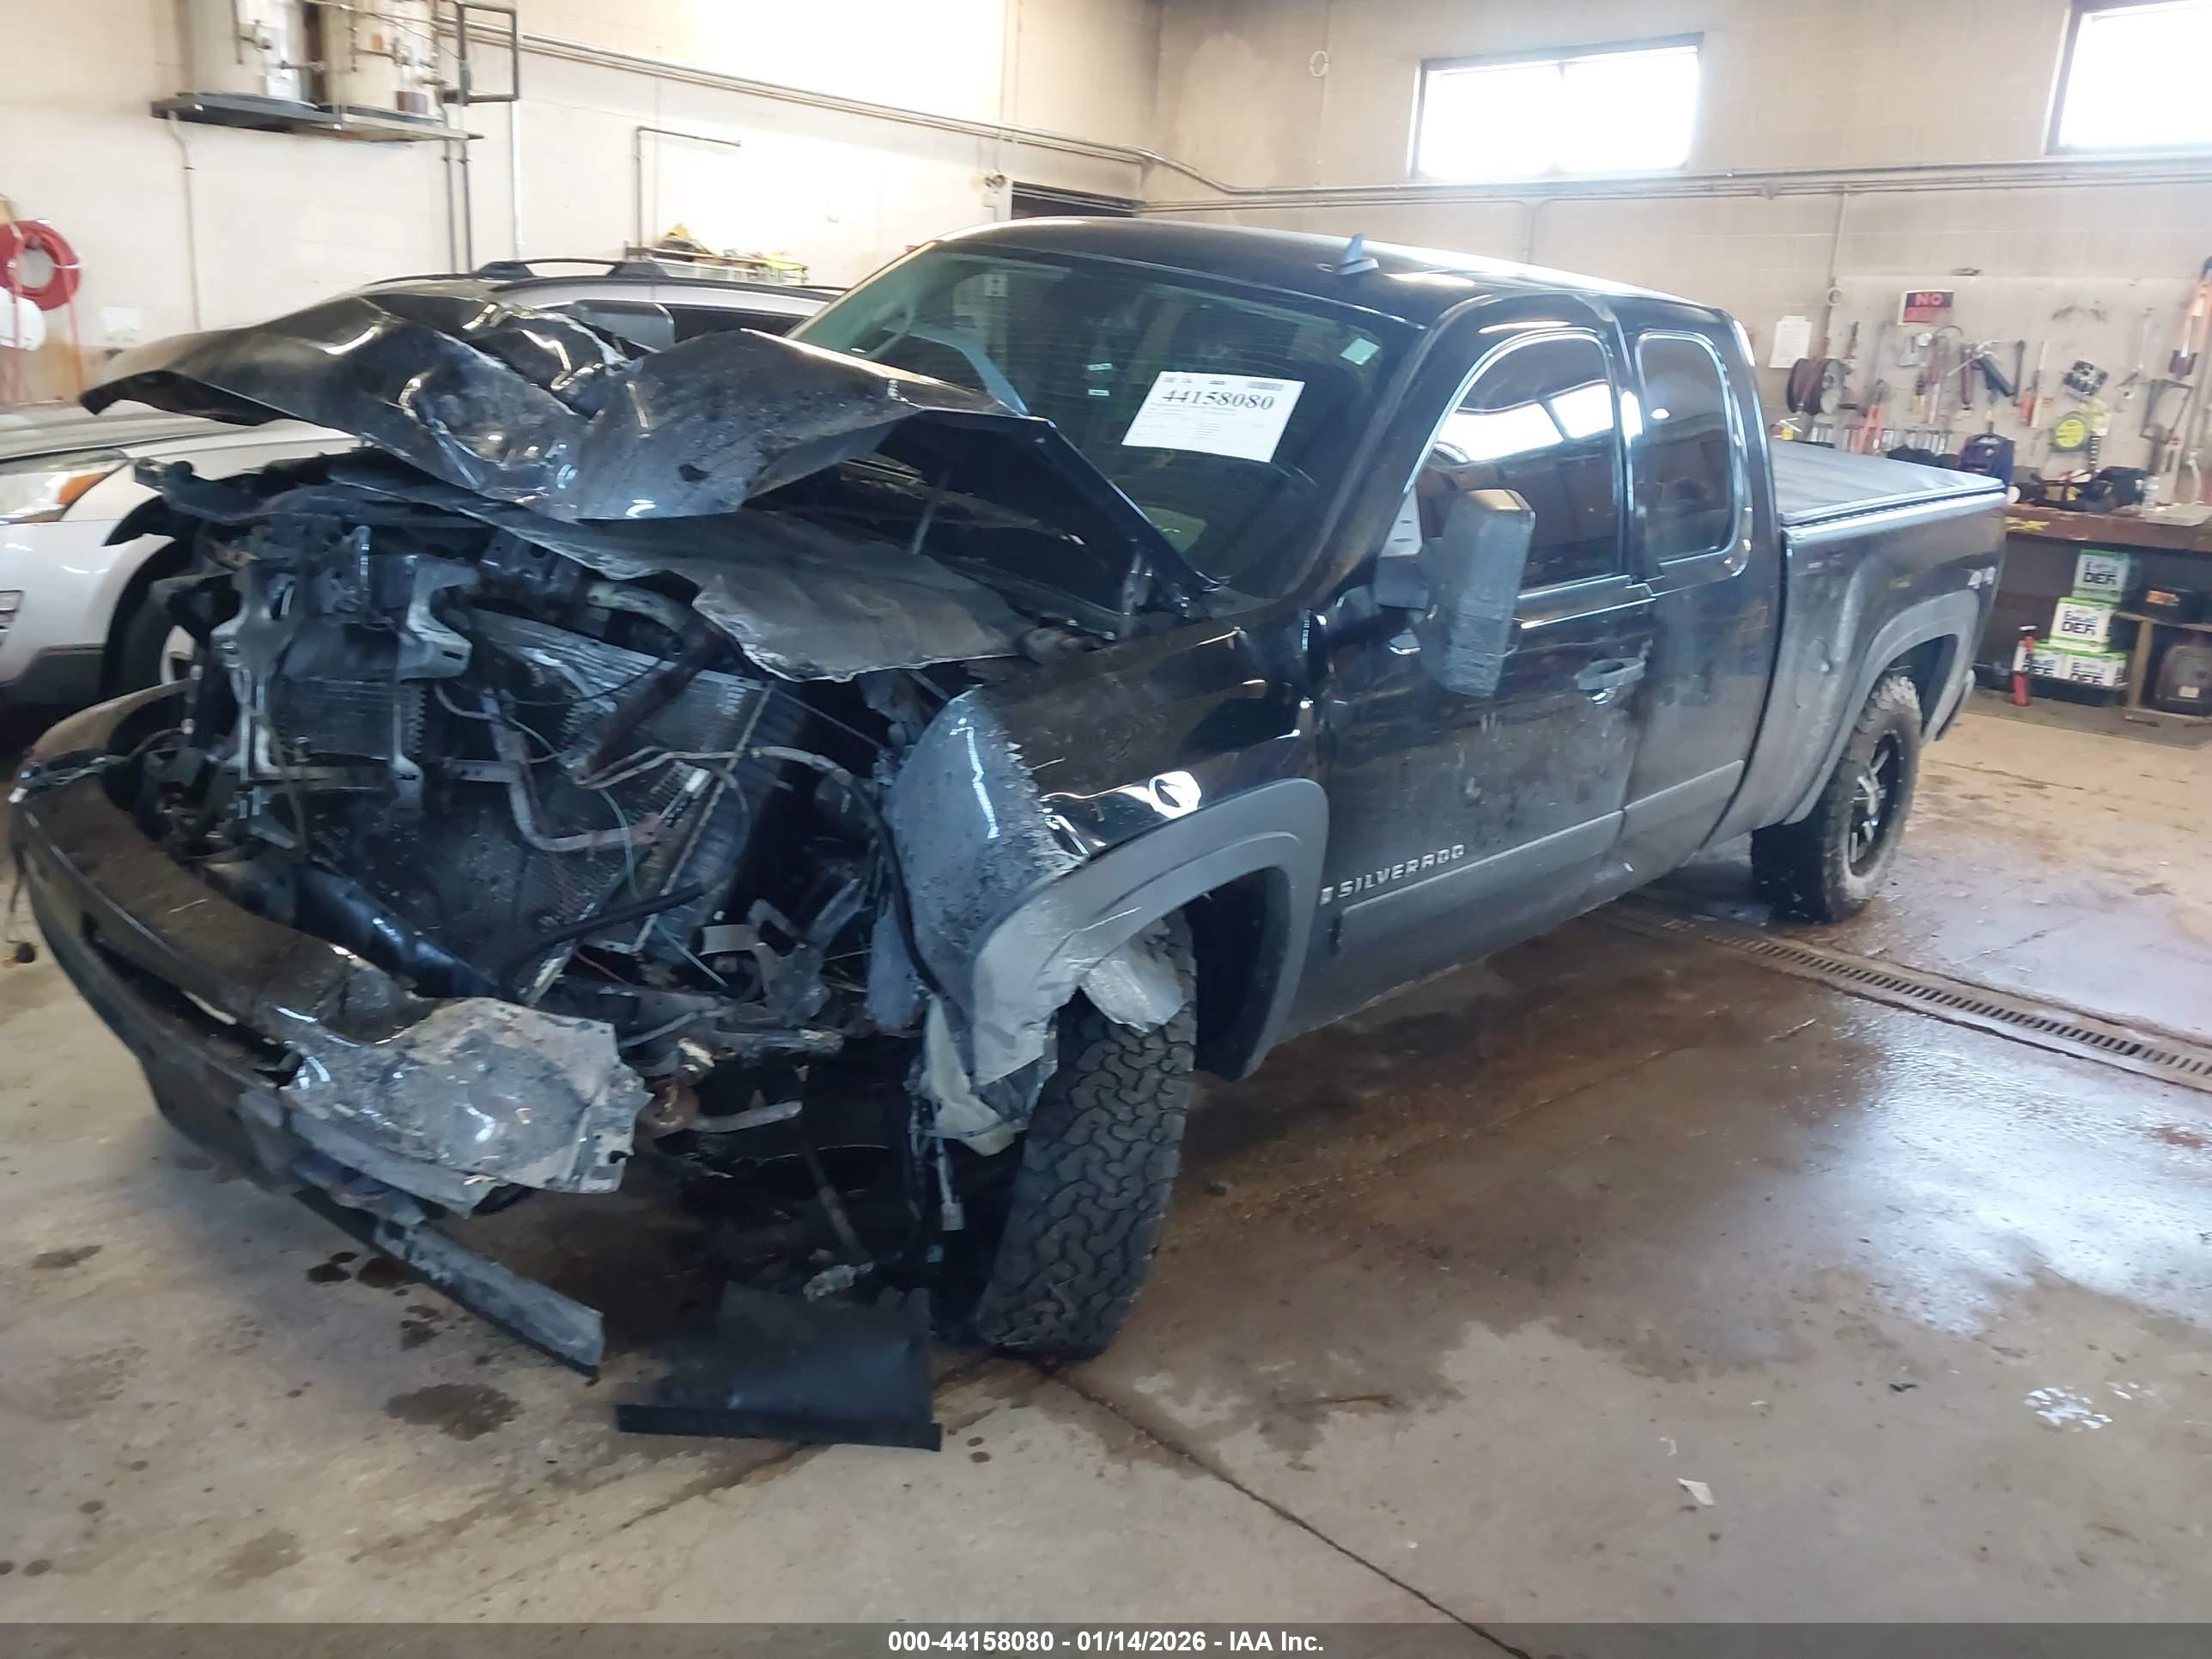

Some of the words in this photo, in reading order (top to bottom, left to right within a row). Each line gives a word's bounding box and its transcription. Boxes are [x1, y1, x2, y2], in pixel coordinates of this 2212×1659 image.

[1914, 293, 1943, 307] NO
[1161, 389, 1275, 410] 44158080
[1337, 844, 1465, 898] SILVERADO
